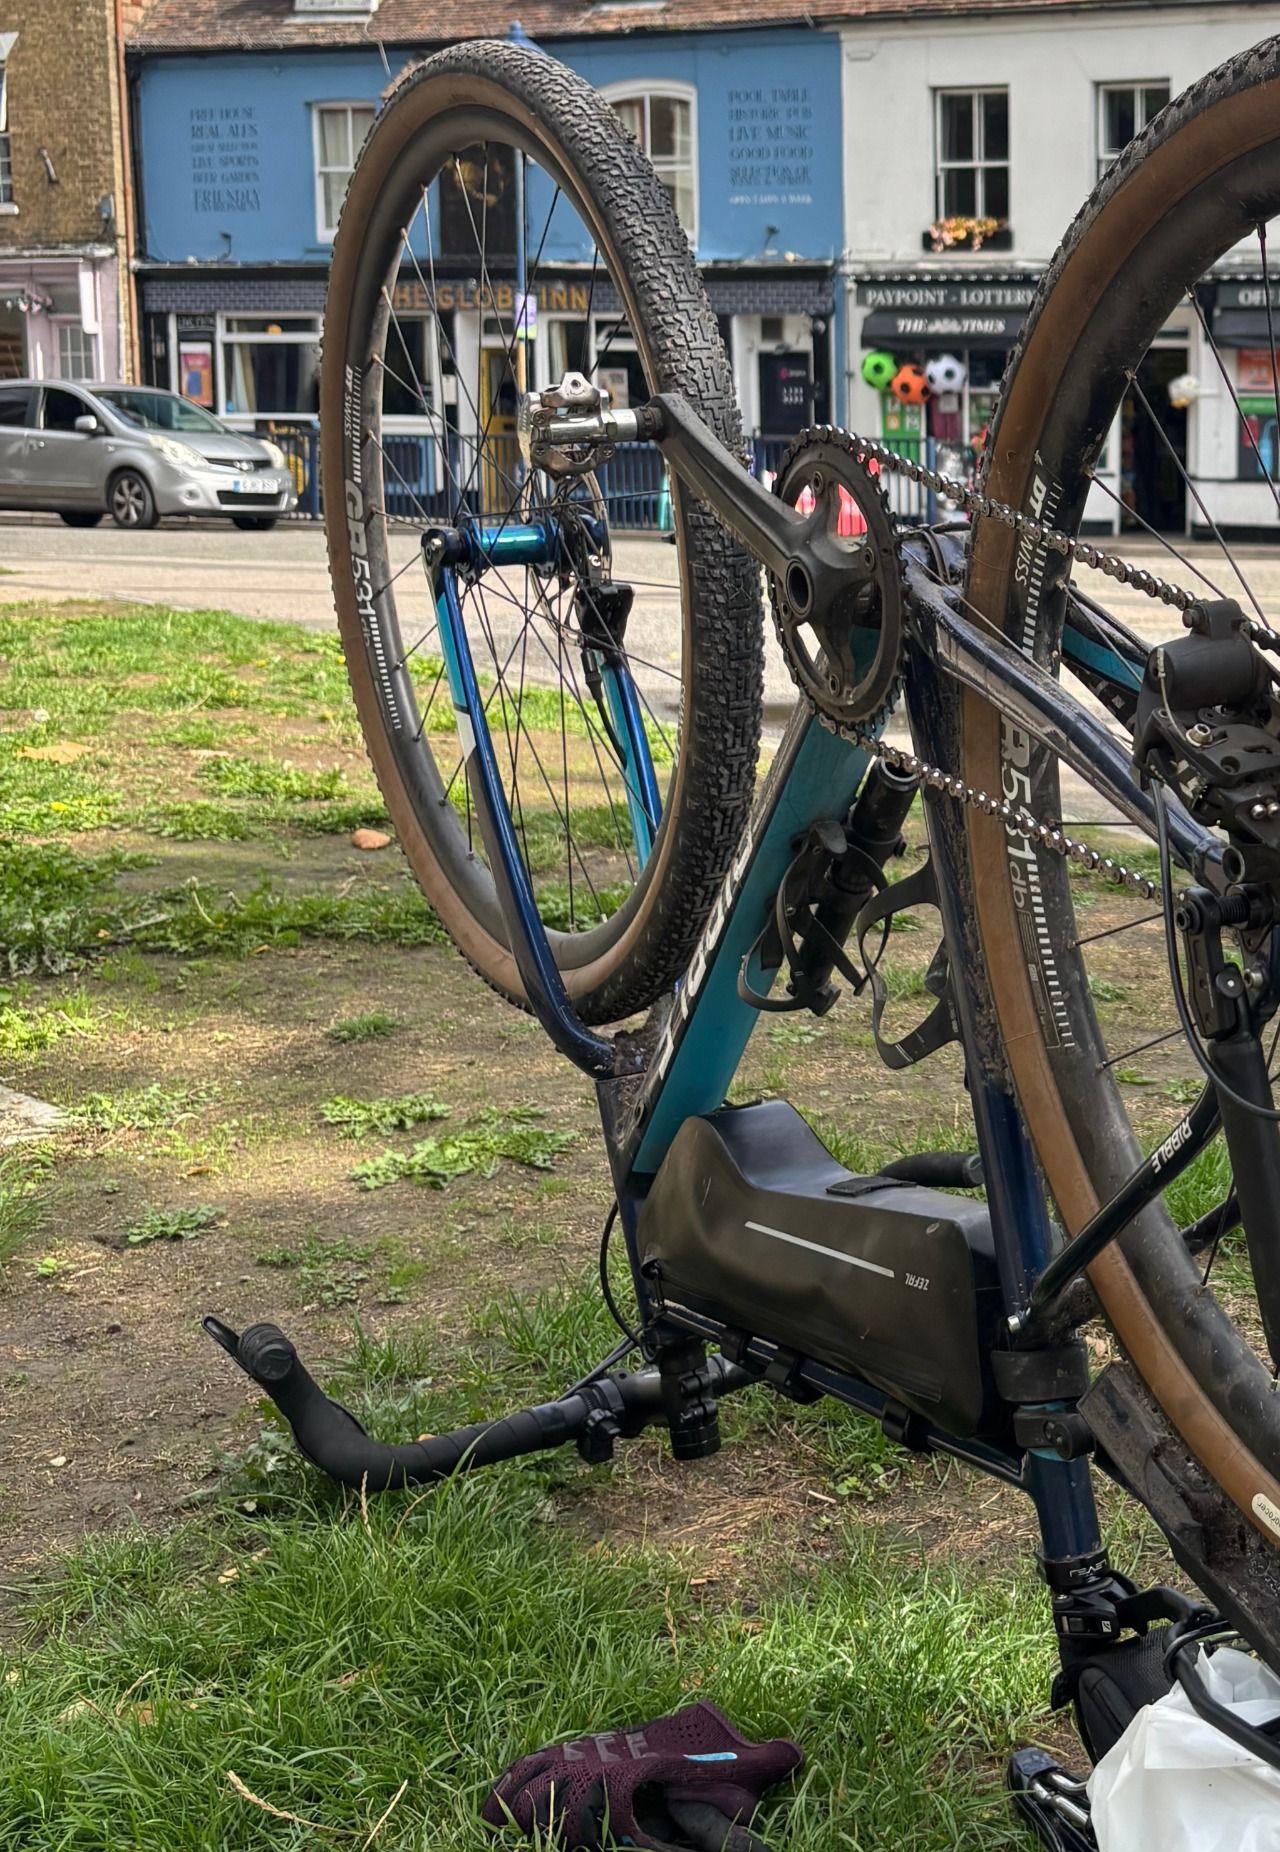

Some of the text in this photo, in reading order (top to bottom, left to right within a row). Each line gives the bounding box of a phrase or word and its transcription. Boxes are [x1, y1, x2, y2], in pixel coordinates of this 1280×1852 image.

[394, 285, 428, 309] HE
[438, 285, 513, 309] GLOB
[539, 285, 588, 310] INN
[865, 288, 948, 306] PAYPOINT
[897, 318, 1006, 333] THE TIMES
[1015, 474, 1046, 586] DT WISS
[1150, 1116, 1193, 1174] RIBBLE
[905, 1272, 930, 1291] ZEFAL
